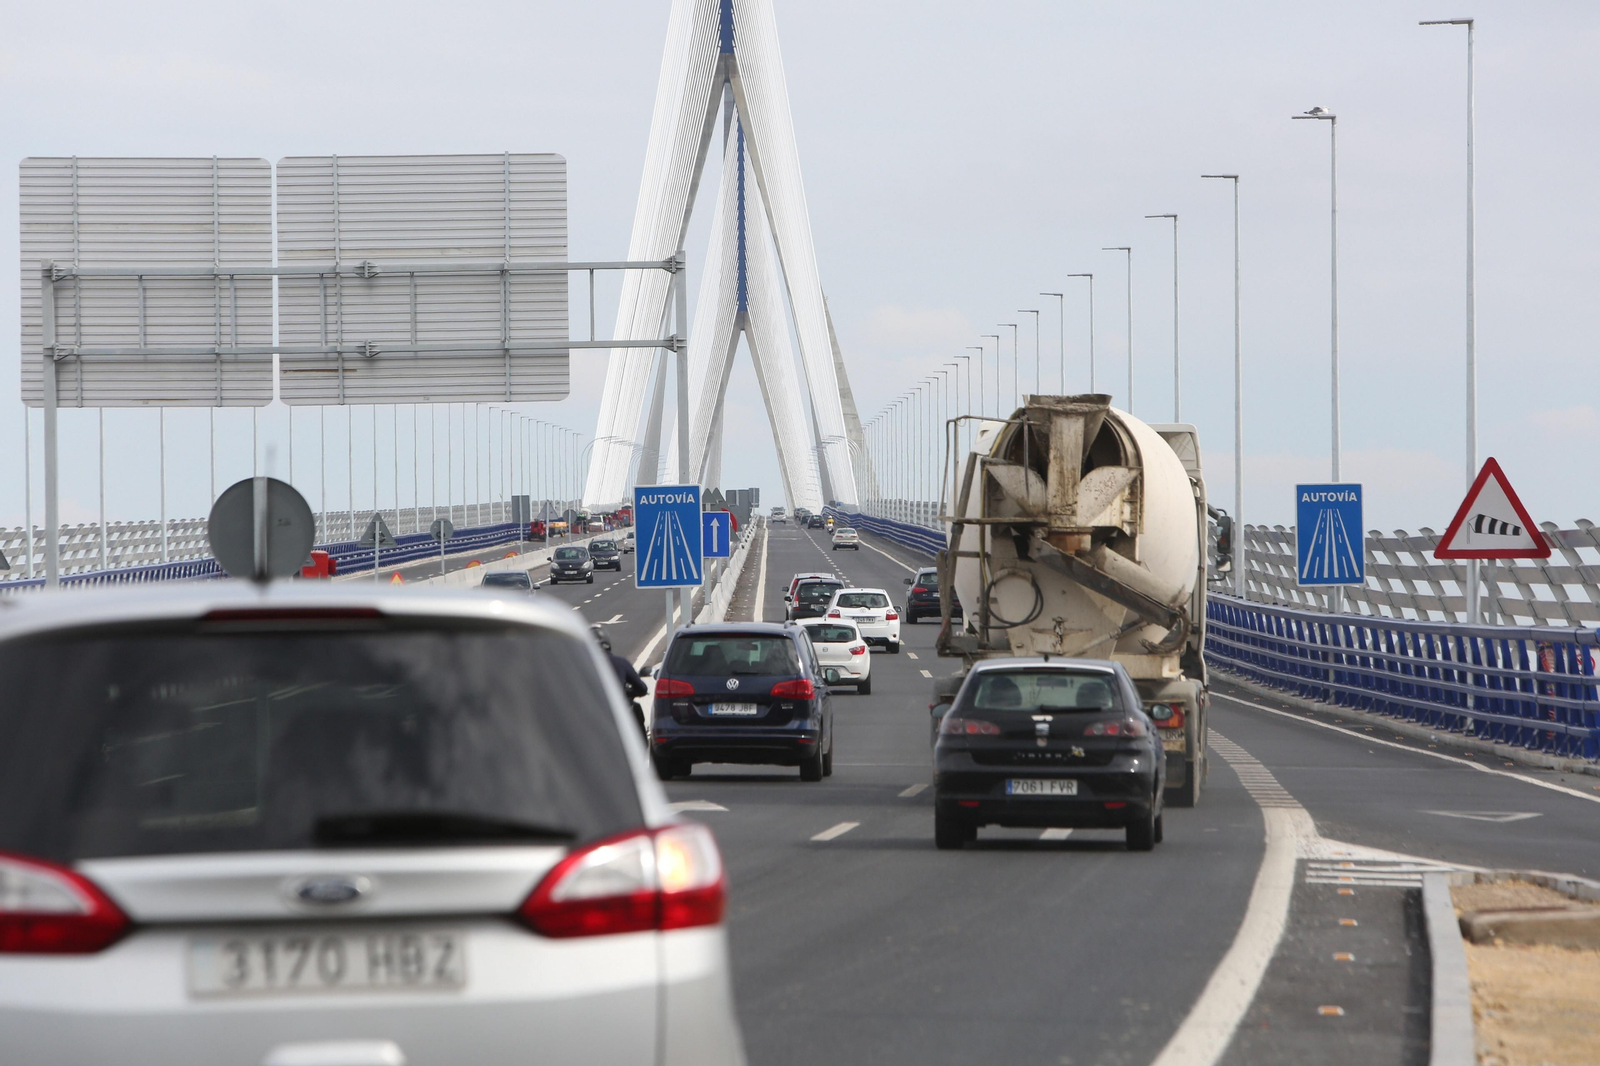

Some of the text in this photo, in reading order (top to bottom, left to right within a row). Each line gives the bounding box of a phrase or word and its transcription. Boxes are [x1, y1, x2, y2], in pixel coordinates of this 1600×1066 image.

[640, 492, 695, 505] AUTOVÍA
[1301, 490, 1358, 502] AUTOVÍA
[1012, 780, 1075, 793] 7061 FVR
[222, 932, 461, 988] 3170 HBZ
